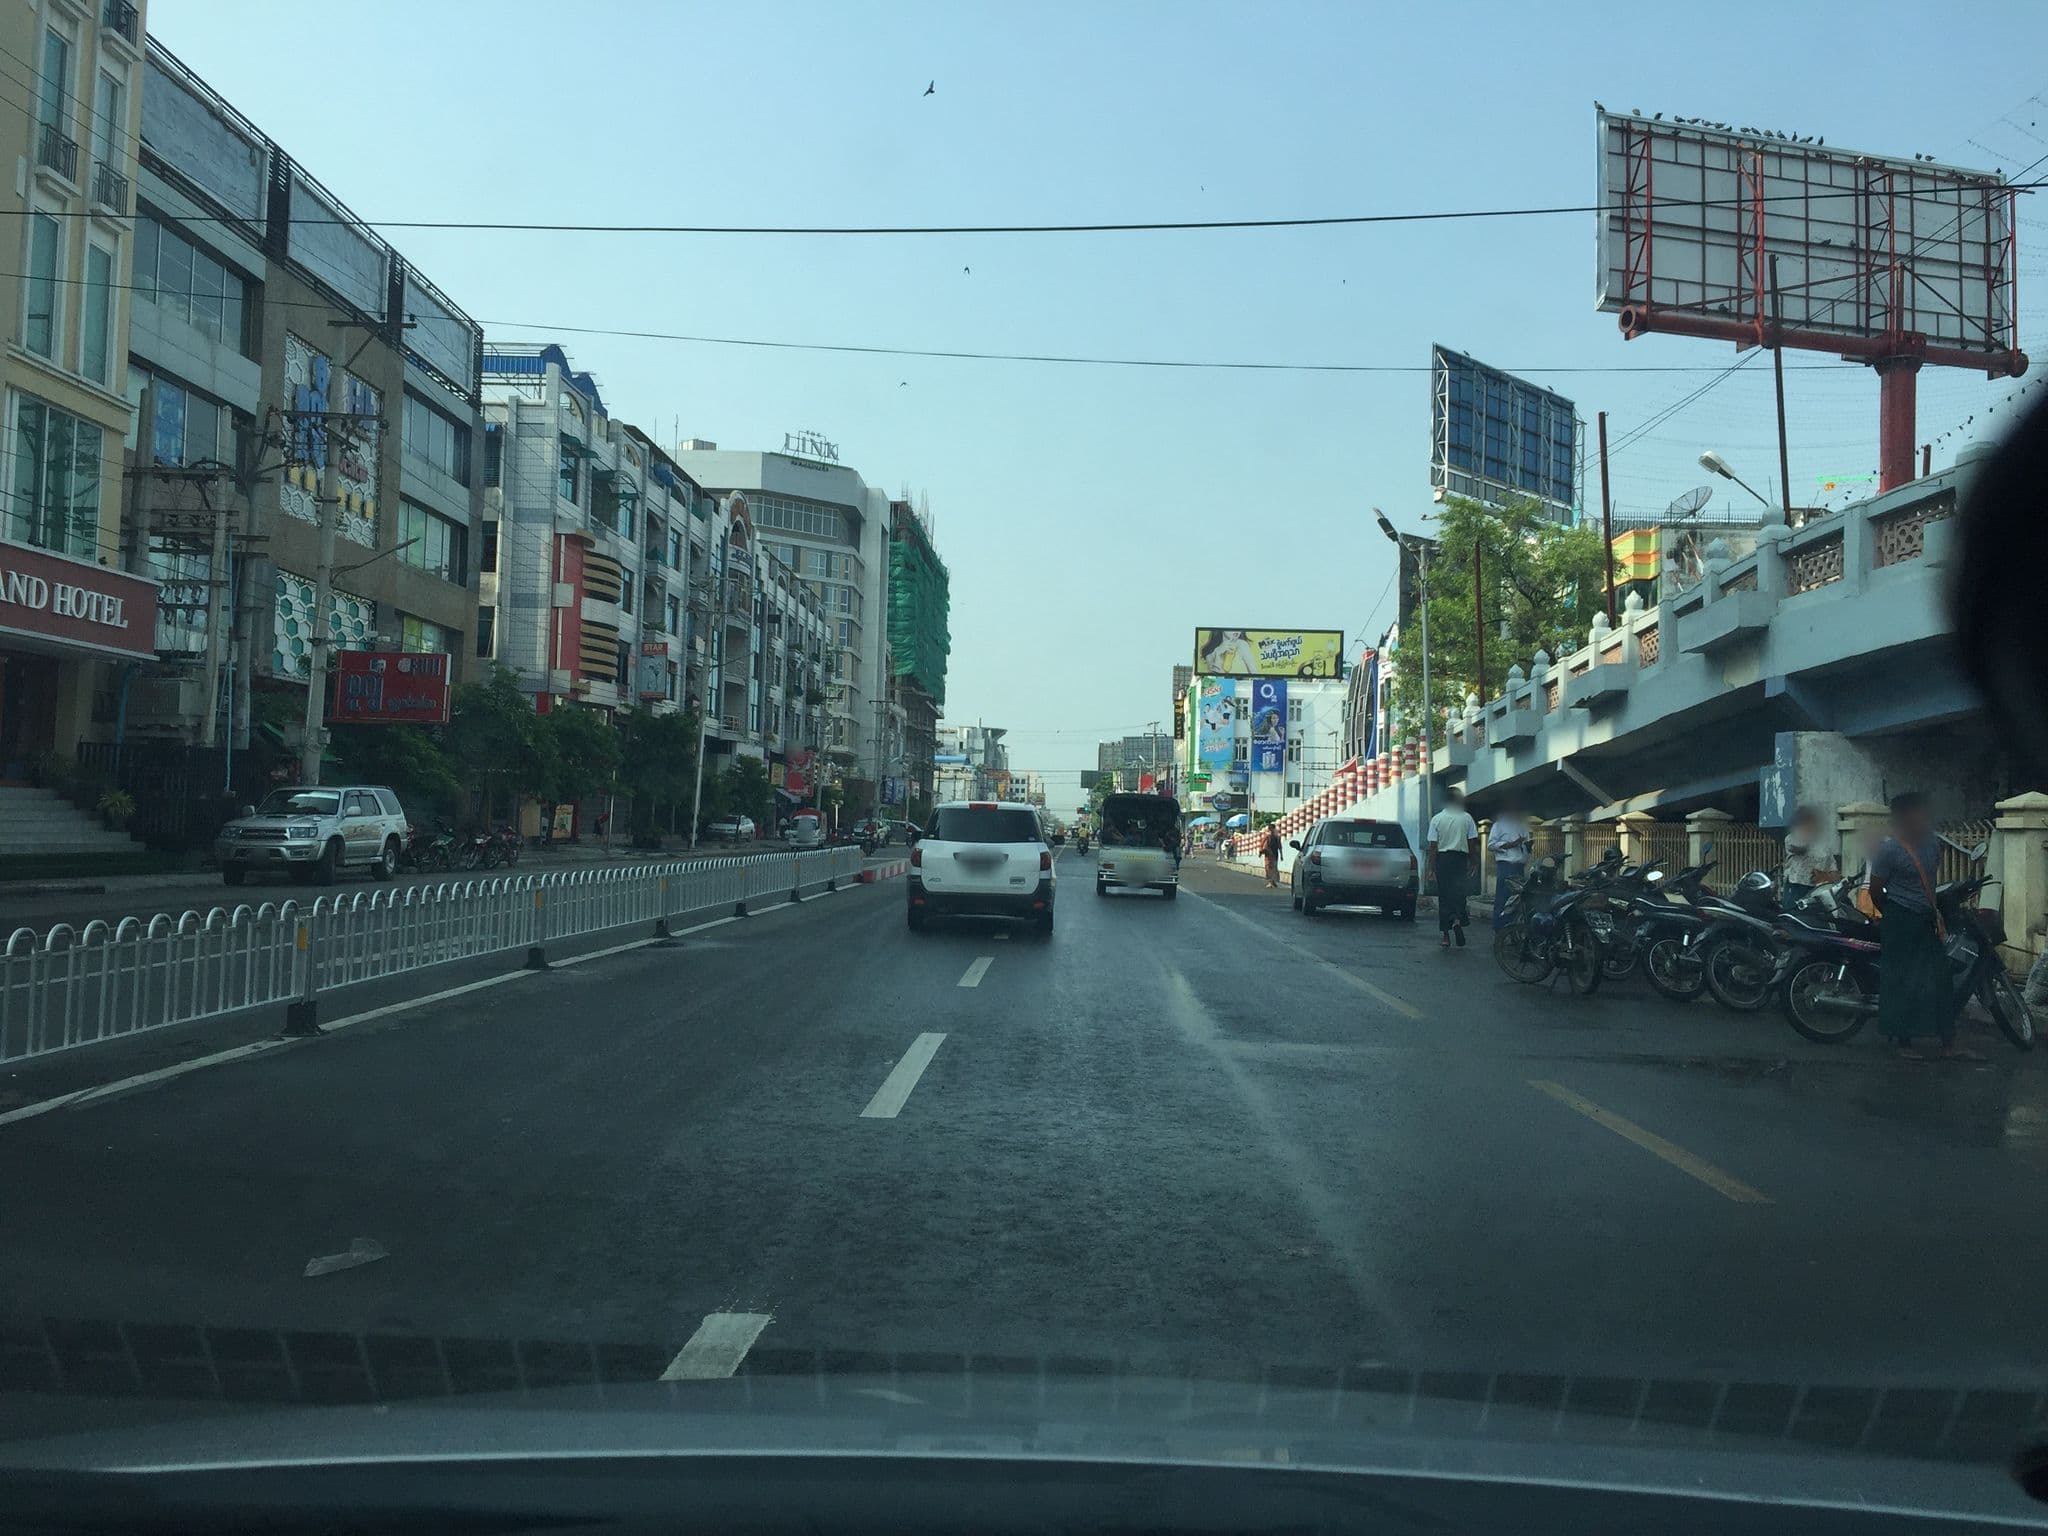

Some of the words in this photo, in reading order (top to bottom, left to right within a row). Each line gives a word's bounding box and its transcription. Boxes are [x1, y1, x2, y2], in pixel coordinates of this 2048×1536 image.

[784, 432, 840, 460] LINK
[51, 582, 129, 628] HOTEL
[644, 643, 664, 651] STAR
